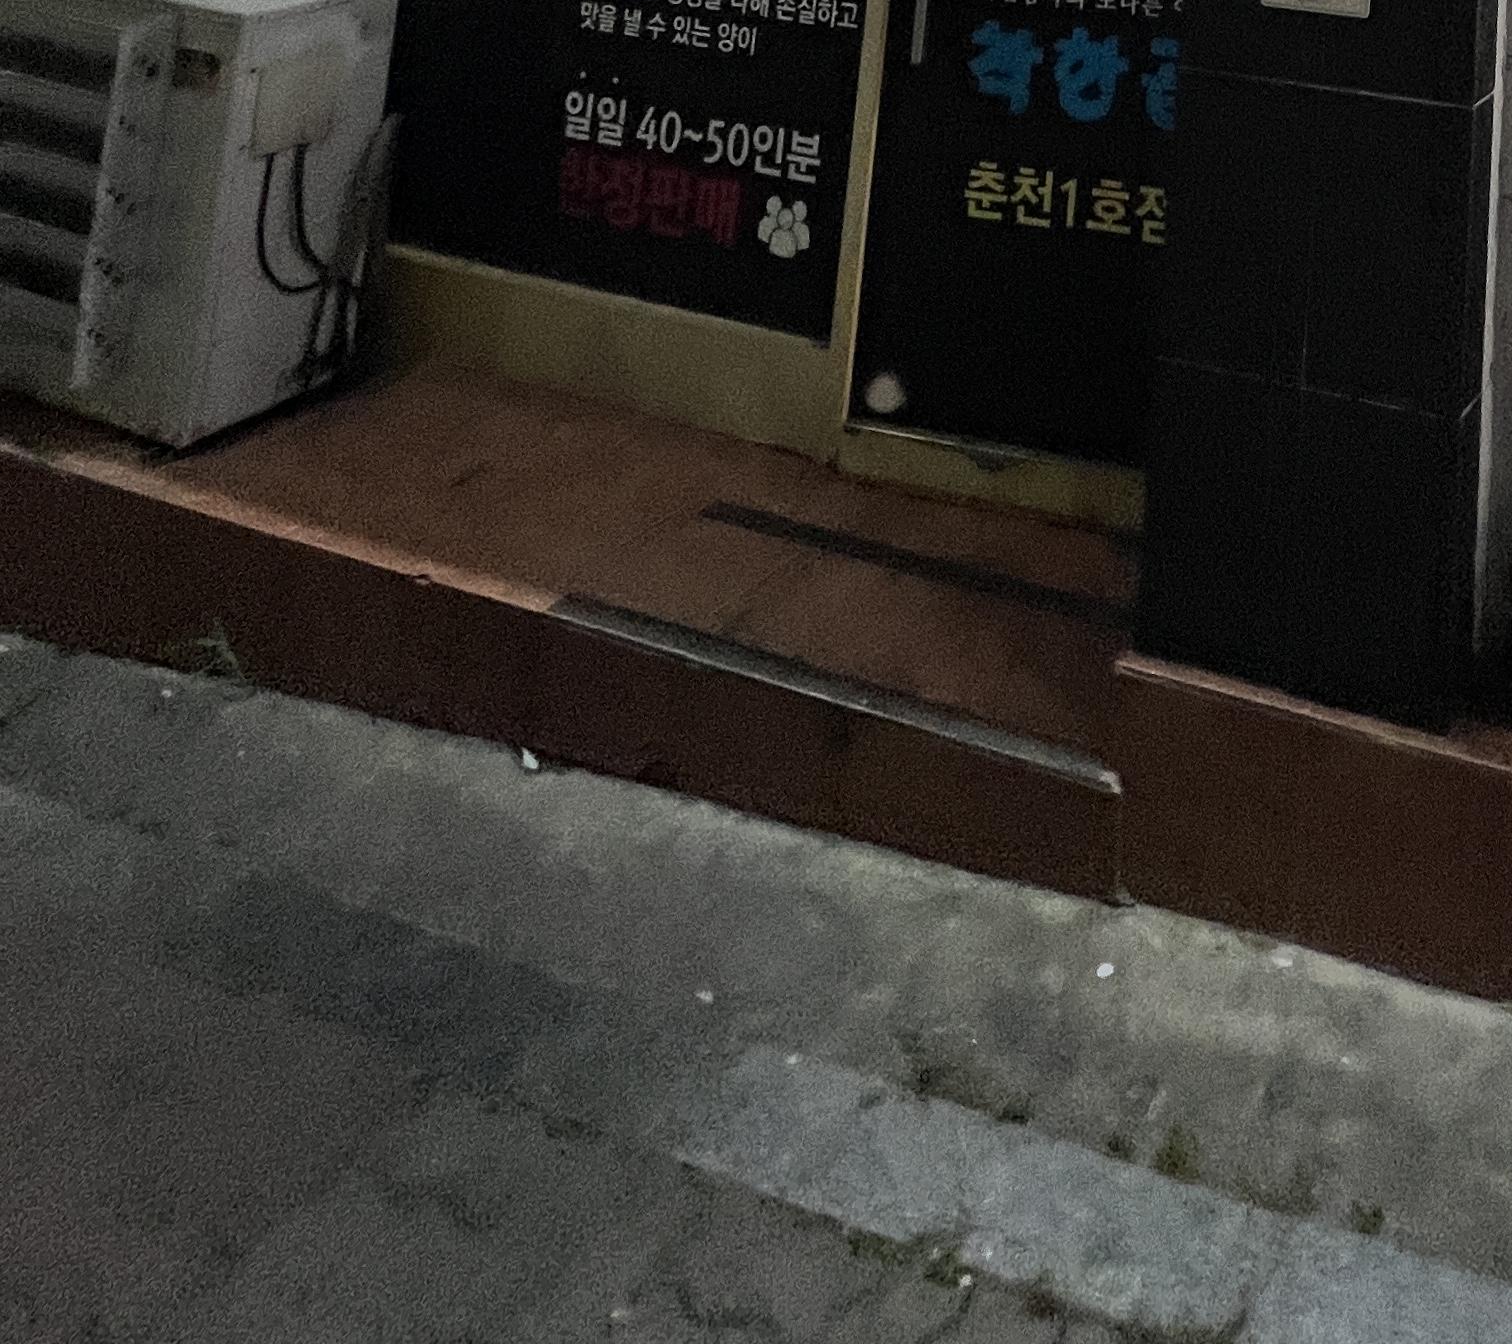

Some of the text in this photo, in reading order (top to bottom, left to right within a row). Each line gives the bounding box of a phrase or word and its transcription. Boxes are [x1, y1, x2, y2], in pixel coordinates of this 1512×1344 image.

[580, 1, 617, 33] 맛을
[646, 13, 666, 40] 수
[672, 16, 712, 48] 있는
[717, 23, 759, 56] 양이
[564, 90, 821, 184] 일일 40~50인분
